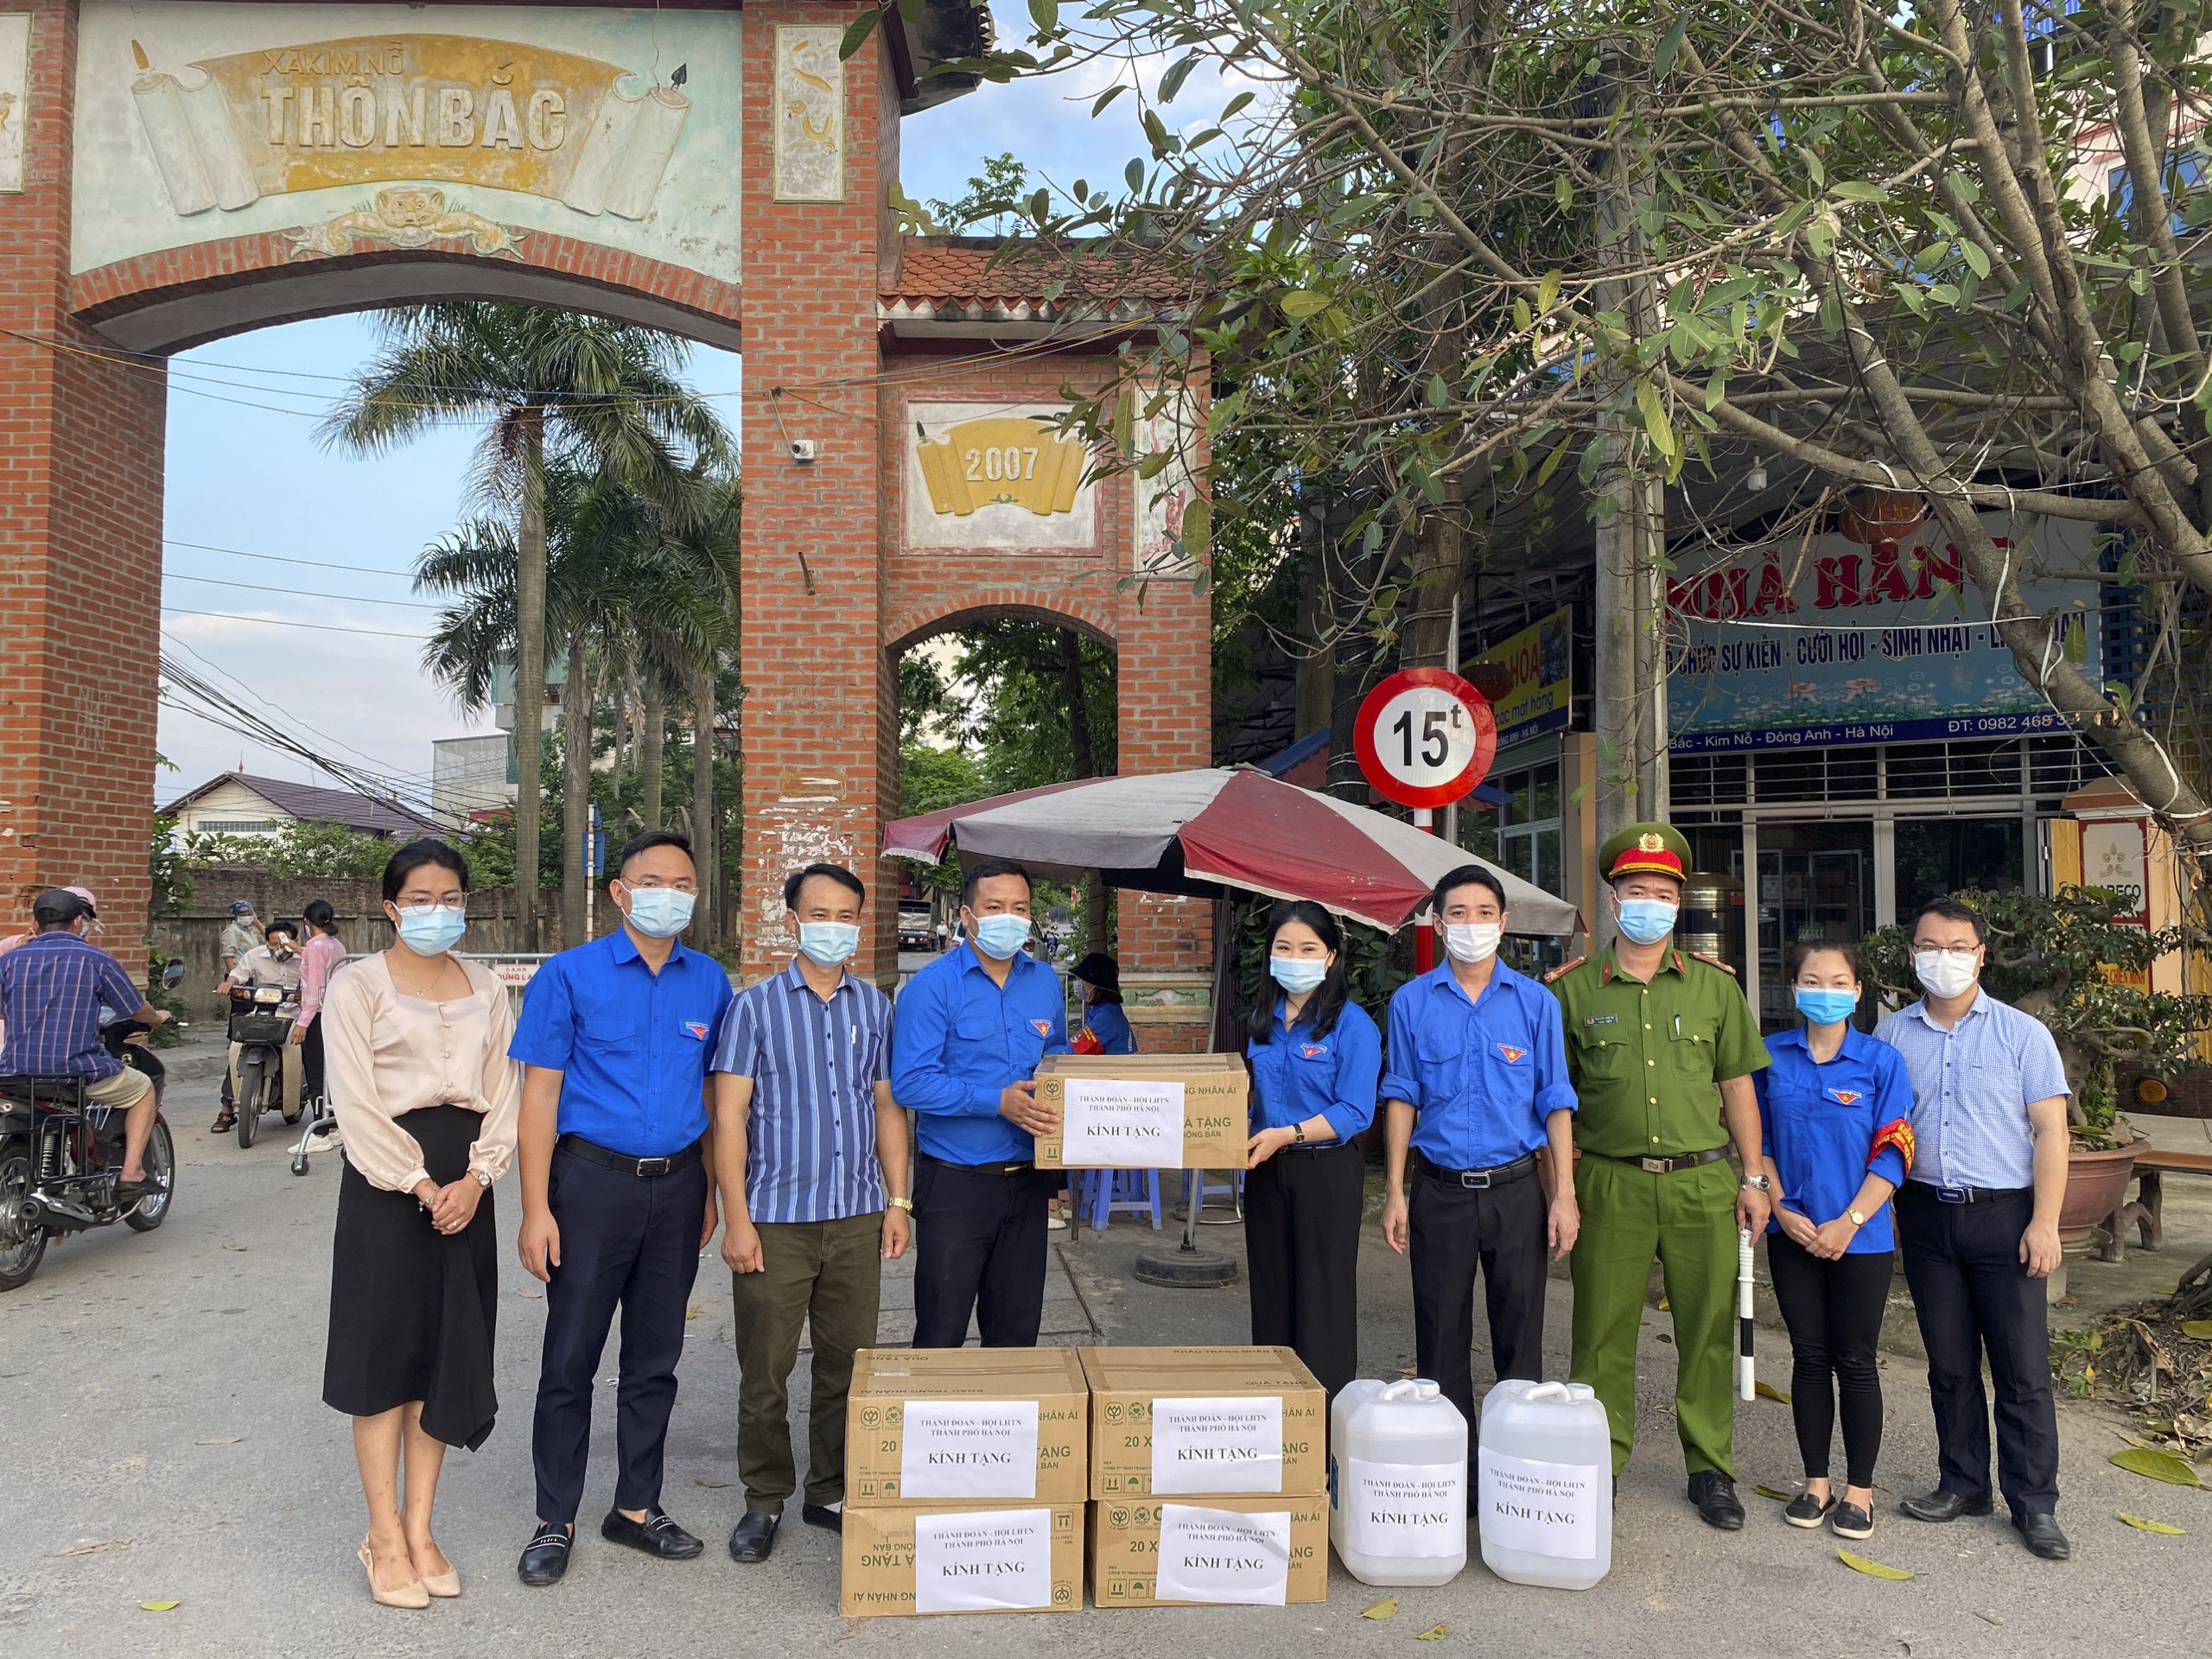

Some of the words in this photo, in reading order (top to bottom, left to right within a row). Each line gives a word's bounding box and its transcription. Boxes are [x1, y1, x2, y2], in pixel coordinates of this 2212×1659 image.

[261, 76, 427, 148] THÔN
[439, 61, 566, 151] BẮC
[964, 446, 1039, 482] 2007
[1745, 633, 1782, 676] KIỆN
[1882, 628, 1923, 658] SINH
[1927, 616, 1971, 659] NHẬT
[1948, 719, 1974, 733] ĐT:
[1978, 715, 2017, 730] 0982
[2021, 714, 2052, 728] 468
[1705, 734, 1730, 747] Kim
[1733, 731, 1752, 746] Nỗ
[1764, 729, 1802, 746] Đông
[1804, 728, 1832, 741] Anh
[1845, 727, 1866, 740] Hà
[1870, 724, 1894, 739] Nội
[1198, 1085, 1224, 1095] NHÂN
[1226, 1085, 1236, 1095] ÁI
[1086, 1123, 1120, 1136] KÍNH
[1124, 1124, 1160, 1139] TẶNG
[1196, 1117, 1231, 1130] TẶNG
[1066, 1410, 1077, 1420] ÁI
[1305, 1408, 1315, 1417] ÁI
[881, 1440, 896, 1452] 20
[1124, 1436, 1140, 1447] 20
[1143, 1436, 1153, 1447] X
[928, 1450, 965, 1464] KÍNH
[970, 1452, 1011, 1466] TẶNG
[1177, 1446, 1213, 1460] KÍNH
[1218, 1448, 1257, 1462] TẶNG
[1040, 1460, 1058, 1470] BÁN
[1310, 1511, 1320, 1522] ÁI
[1370, 1510, 1407, 1524] KÍNH
[1413, 1512, 1448, 1528] TẶNG
[1496, 1501, 1530, 1520] KÍNH
[1535, 1510, 1575, 1527] TẶNG
[1129, 1541, 1145, 1553] 20
[1149, 1541, 1158, 1552] X
[943, 1562, 980, 1576] KÍNH
[984, 1561, 1025, 1576] TẶNG
[1184, 1554, 1220, 1569] KÍNH
[1226, 1557, 1263, 1572] TẶNG
